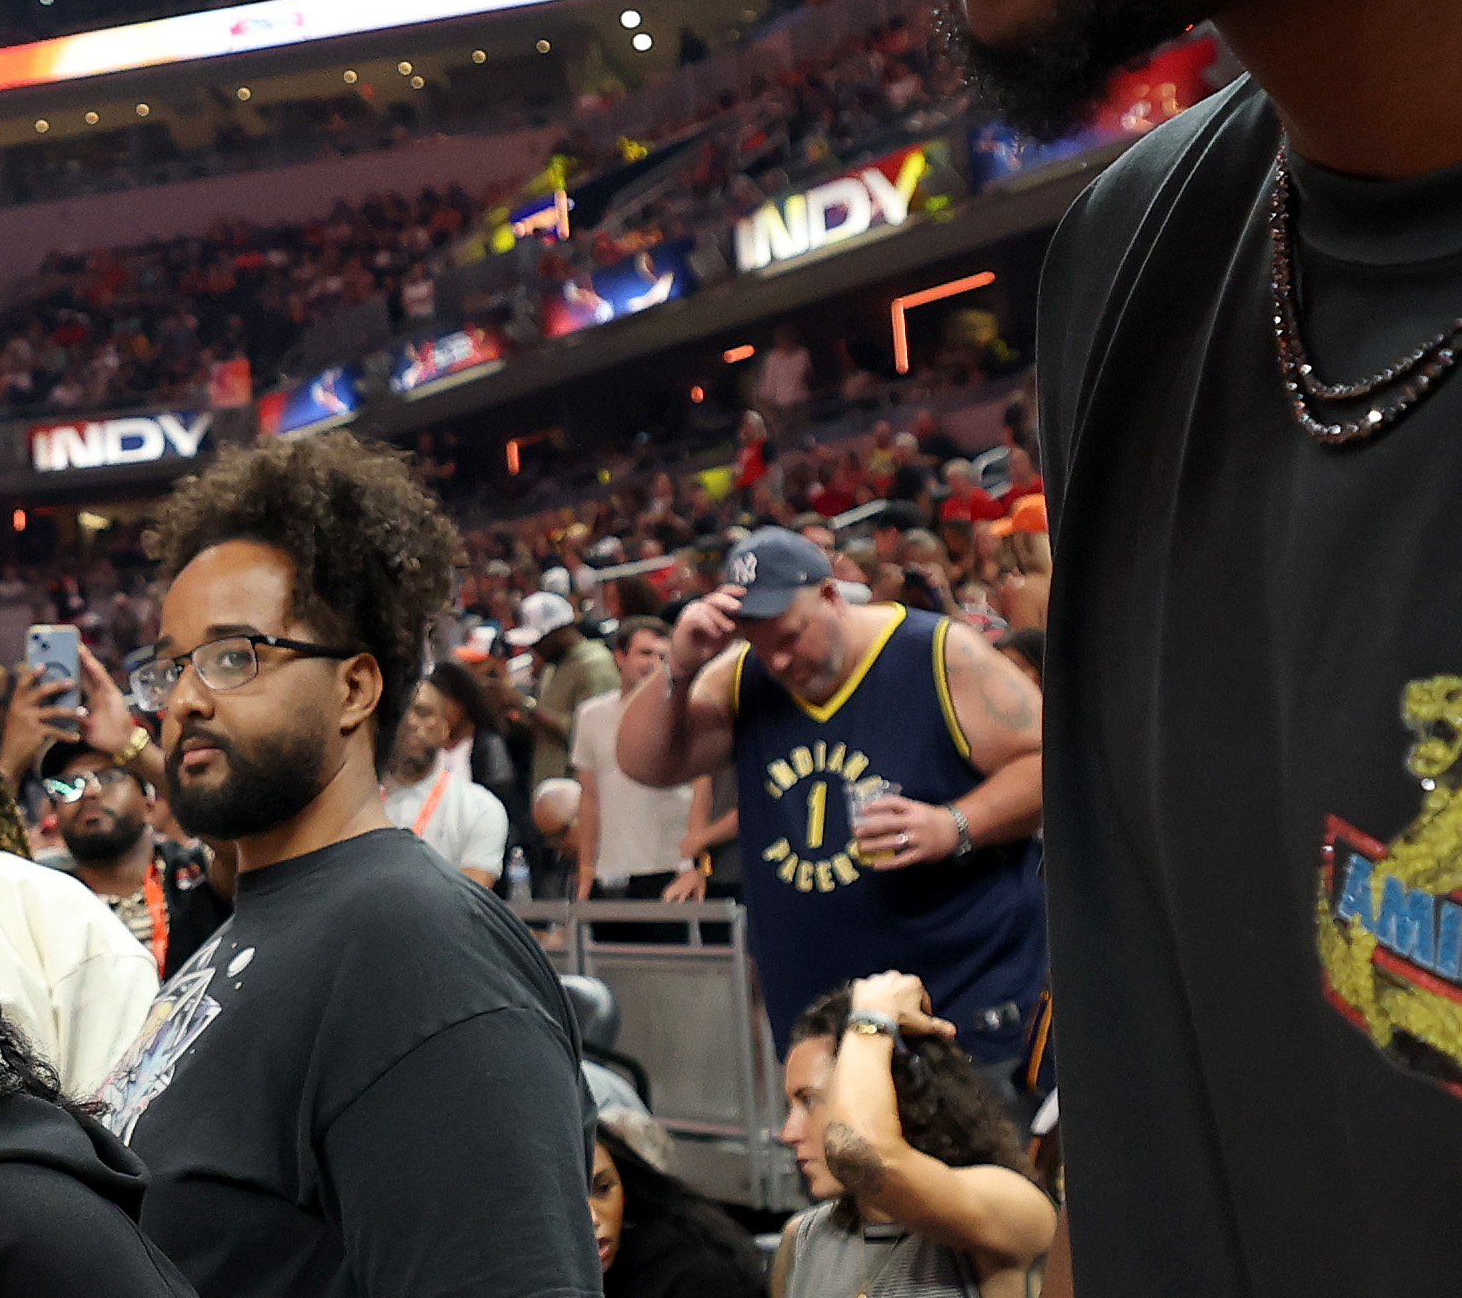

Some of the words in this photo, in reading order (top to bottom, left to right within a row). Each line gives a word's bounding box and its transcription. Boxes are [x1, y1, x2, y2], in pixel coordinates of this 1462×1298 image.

[735, 148, 926, 273] INDY
[32, 410, 215, 472] INDY
[806, 780, 828, 849] 1
